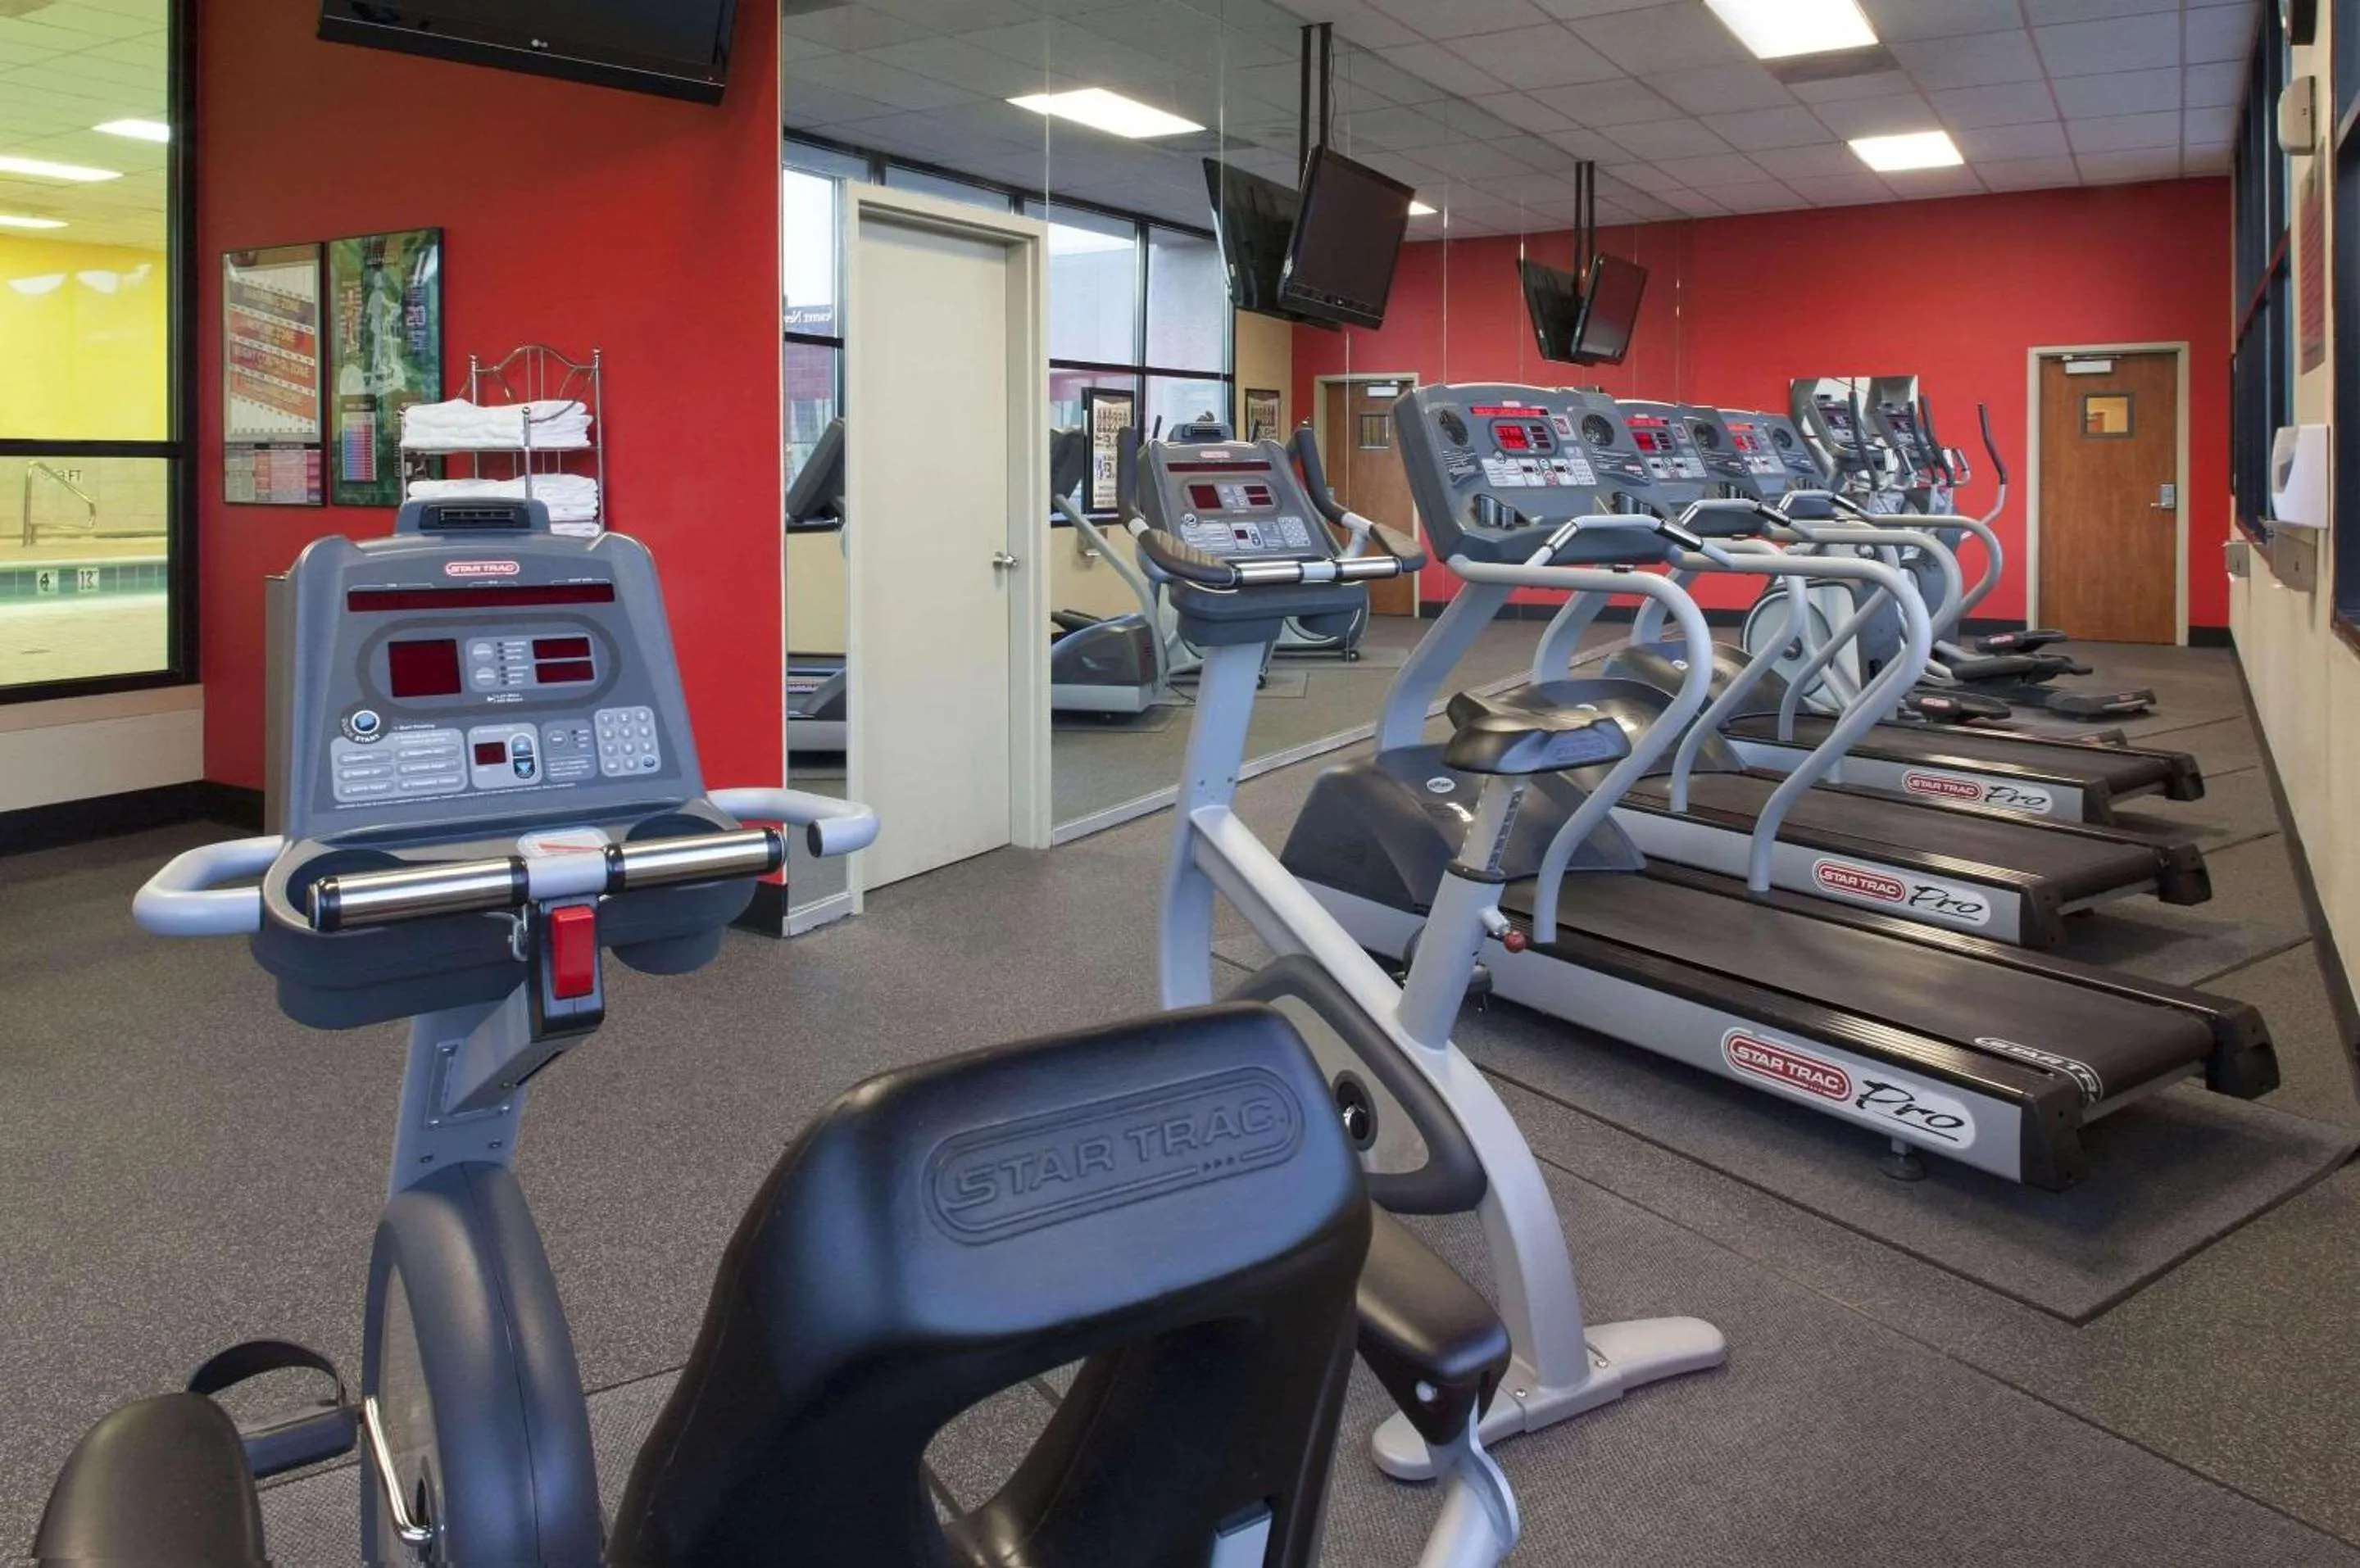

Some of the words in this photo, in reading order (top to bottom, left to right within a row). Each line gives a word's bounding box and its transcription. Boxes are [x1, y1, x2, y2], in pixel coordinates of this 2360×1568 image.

[69, 469, 82, 482] FT
[450, 565, 481, 573] STAR
[483, 564, 515, 573] TRAC
[1912, 779, 1941, 791] STAR
[1943, 784, 1976, 795] TRAC
[1984, 786, 2047, 806] Pro
[1821, 870, 1858, 886] STAR
[1859, 880, 1898, 895] TRAC
[1908, 885, 1984, 913] Pro
[1731, 1045, 1786, 1072] STAR
[1786, 1063, 1842, 1090] TRAC
[1854, 1079, 1966, 1129] Pro
[947, 1135, 1116, 1211] STAR
[1127, 1094, 1277, 1163] TRAC
